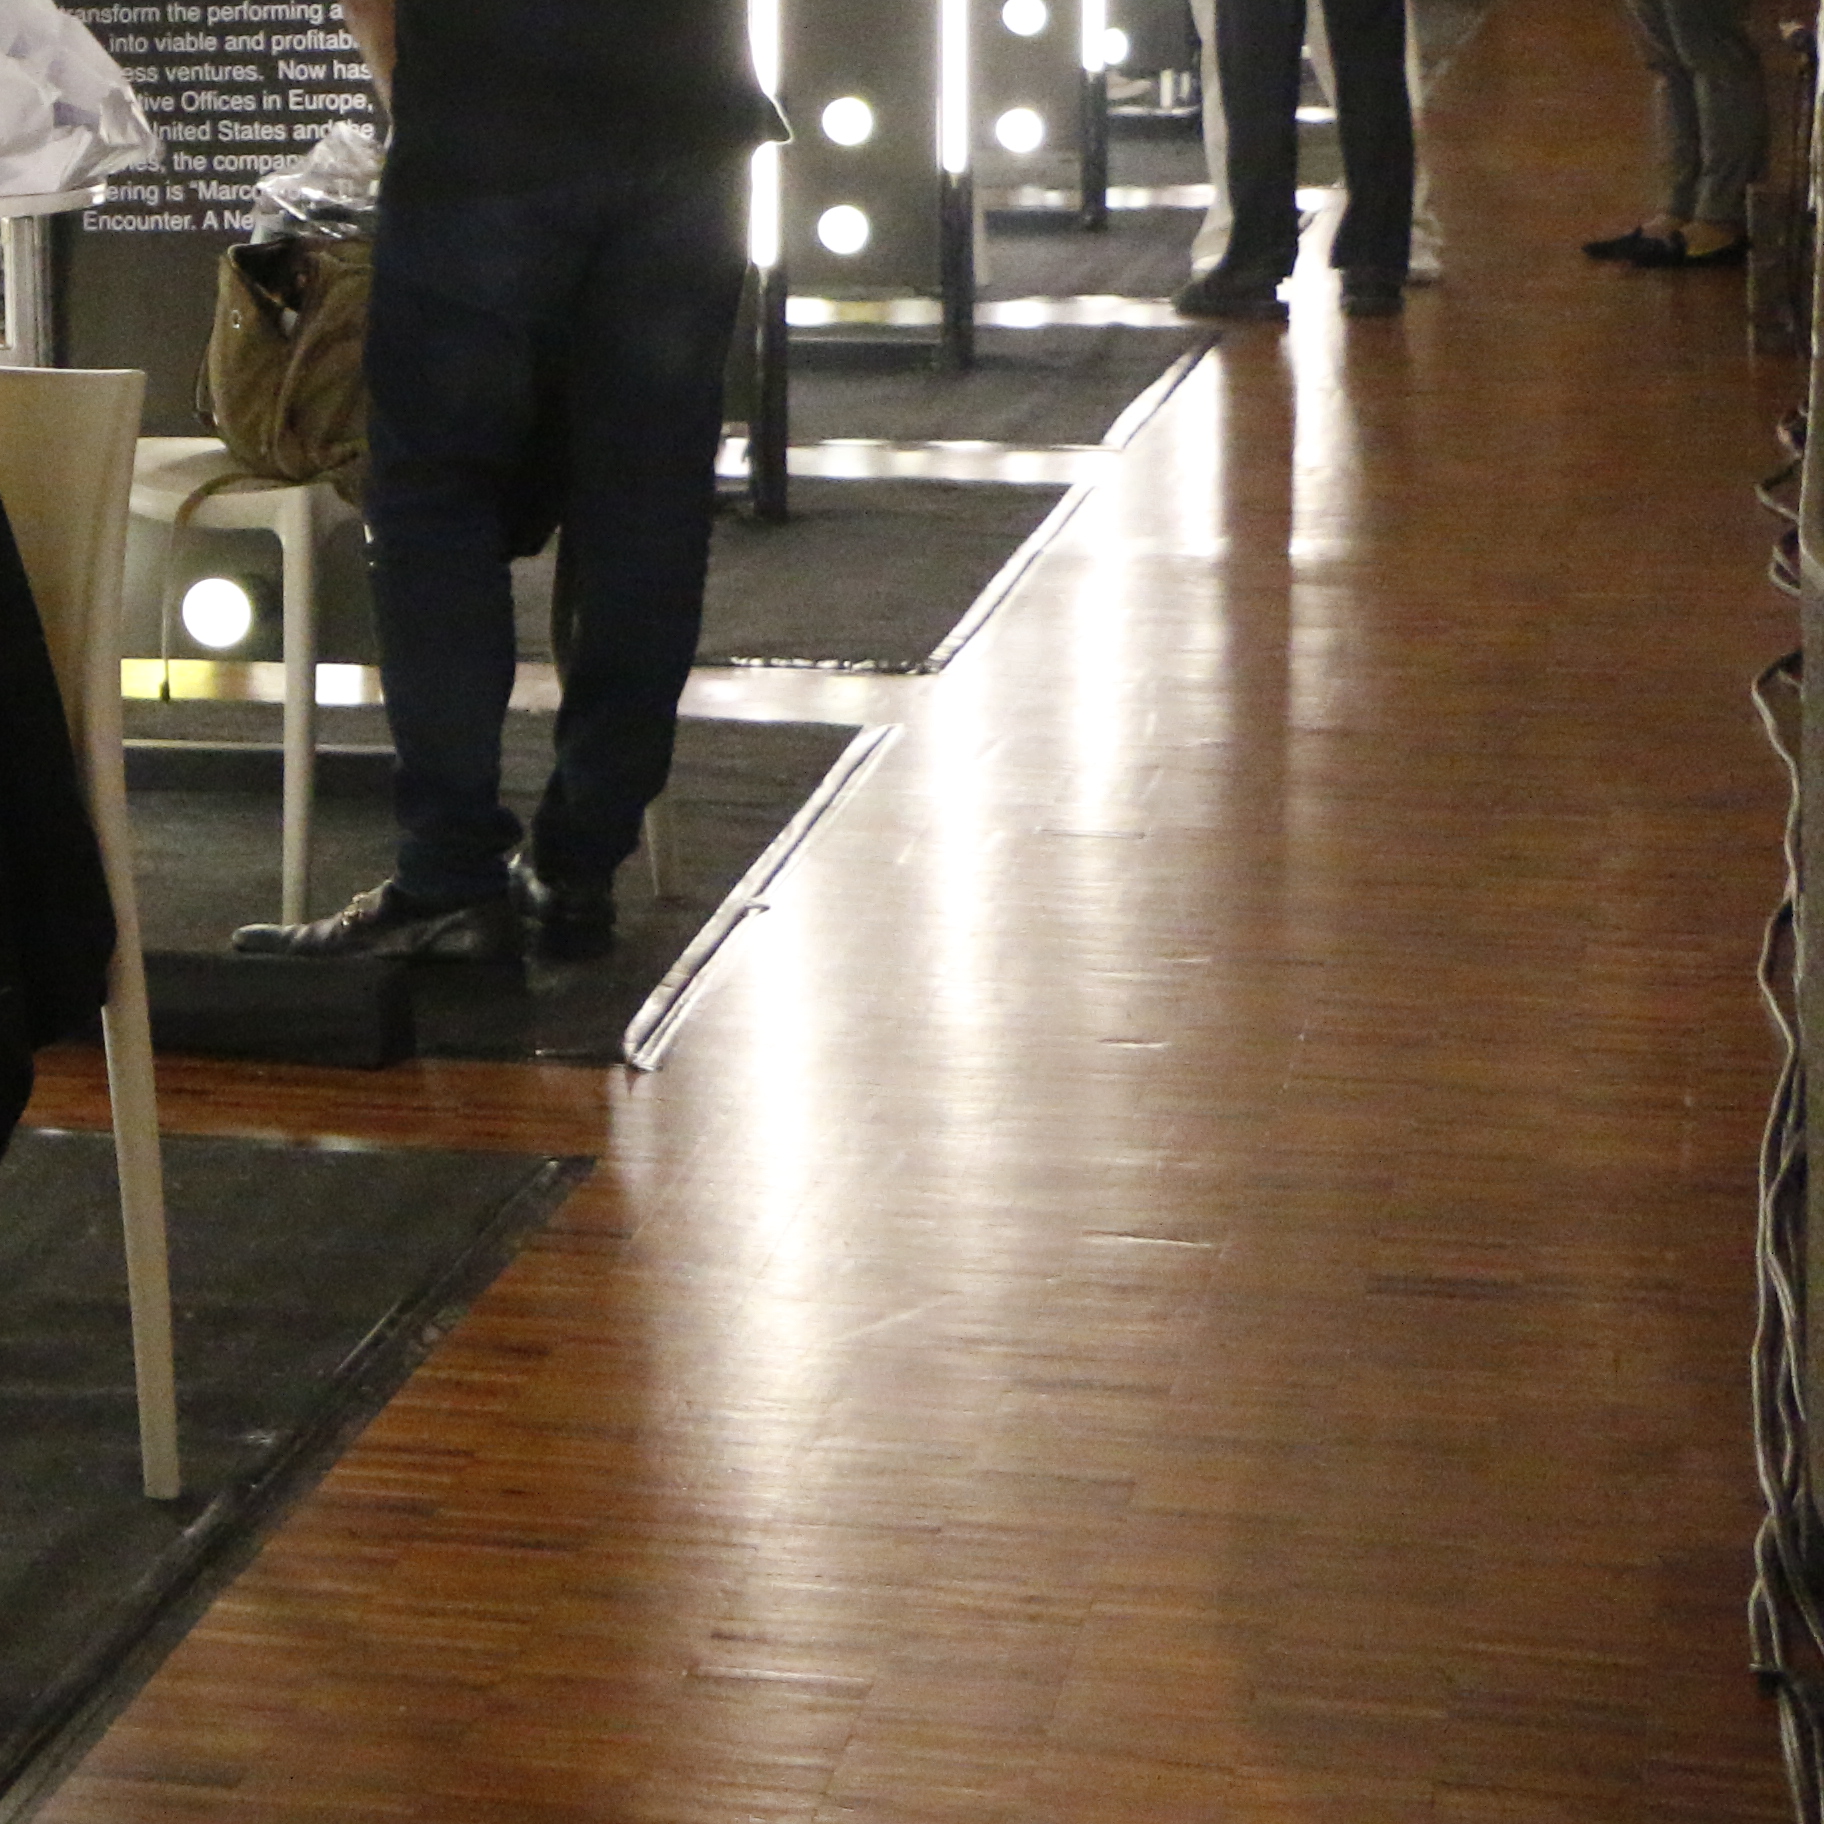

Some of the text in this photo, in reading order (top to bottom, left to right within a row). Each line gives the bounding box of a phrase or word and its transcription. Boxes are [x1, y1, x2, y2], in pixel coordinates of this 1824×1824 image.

[166, 2, 200, 22] the
[207, 0, 323, 25] performing
[109, 28, 362, 56] into viable and profitab
[164, 64, 264, 82] ventures.
[277, 60, 329, 80] Now
[332, 58, 374, 79] has
[180, 90, 257, 112] Offices
[262, 90, 282, 111] in
[287, 89, 374, 114] Europe,
[217, 120, 283, 141] States
[172, 152, 204, 171] the
[166, 180, 184, 202] is
[82, 210, 197, 232] Encounter.
[202, 210, 221, 230] A
